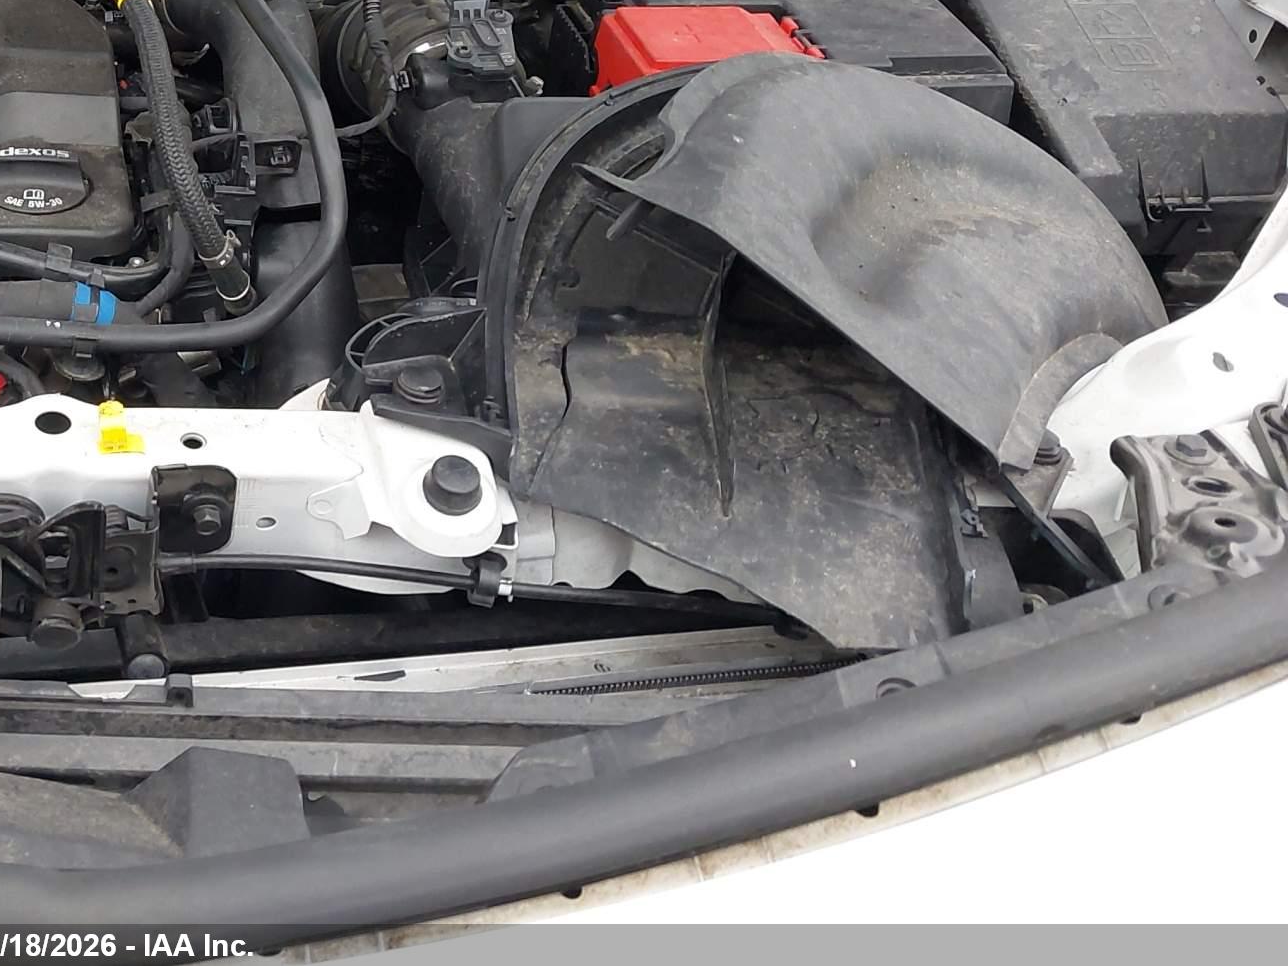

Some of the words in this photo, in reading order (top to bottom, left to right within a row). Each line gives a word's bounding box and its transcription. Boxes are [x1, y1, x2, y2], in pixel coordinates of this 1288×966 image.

[0, 146, 70, 159] dexos
[4, 195, 25, 207] SAE
[27, 197, 63, 208] 5W-30
